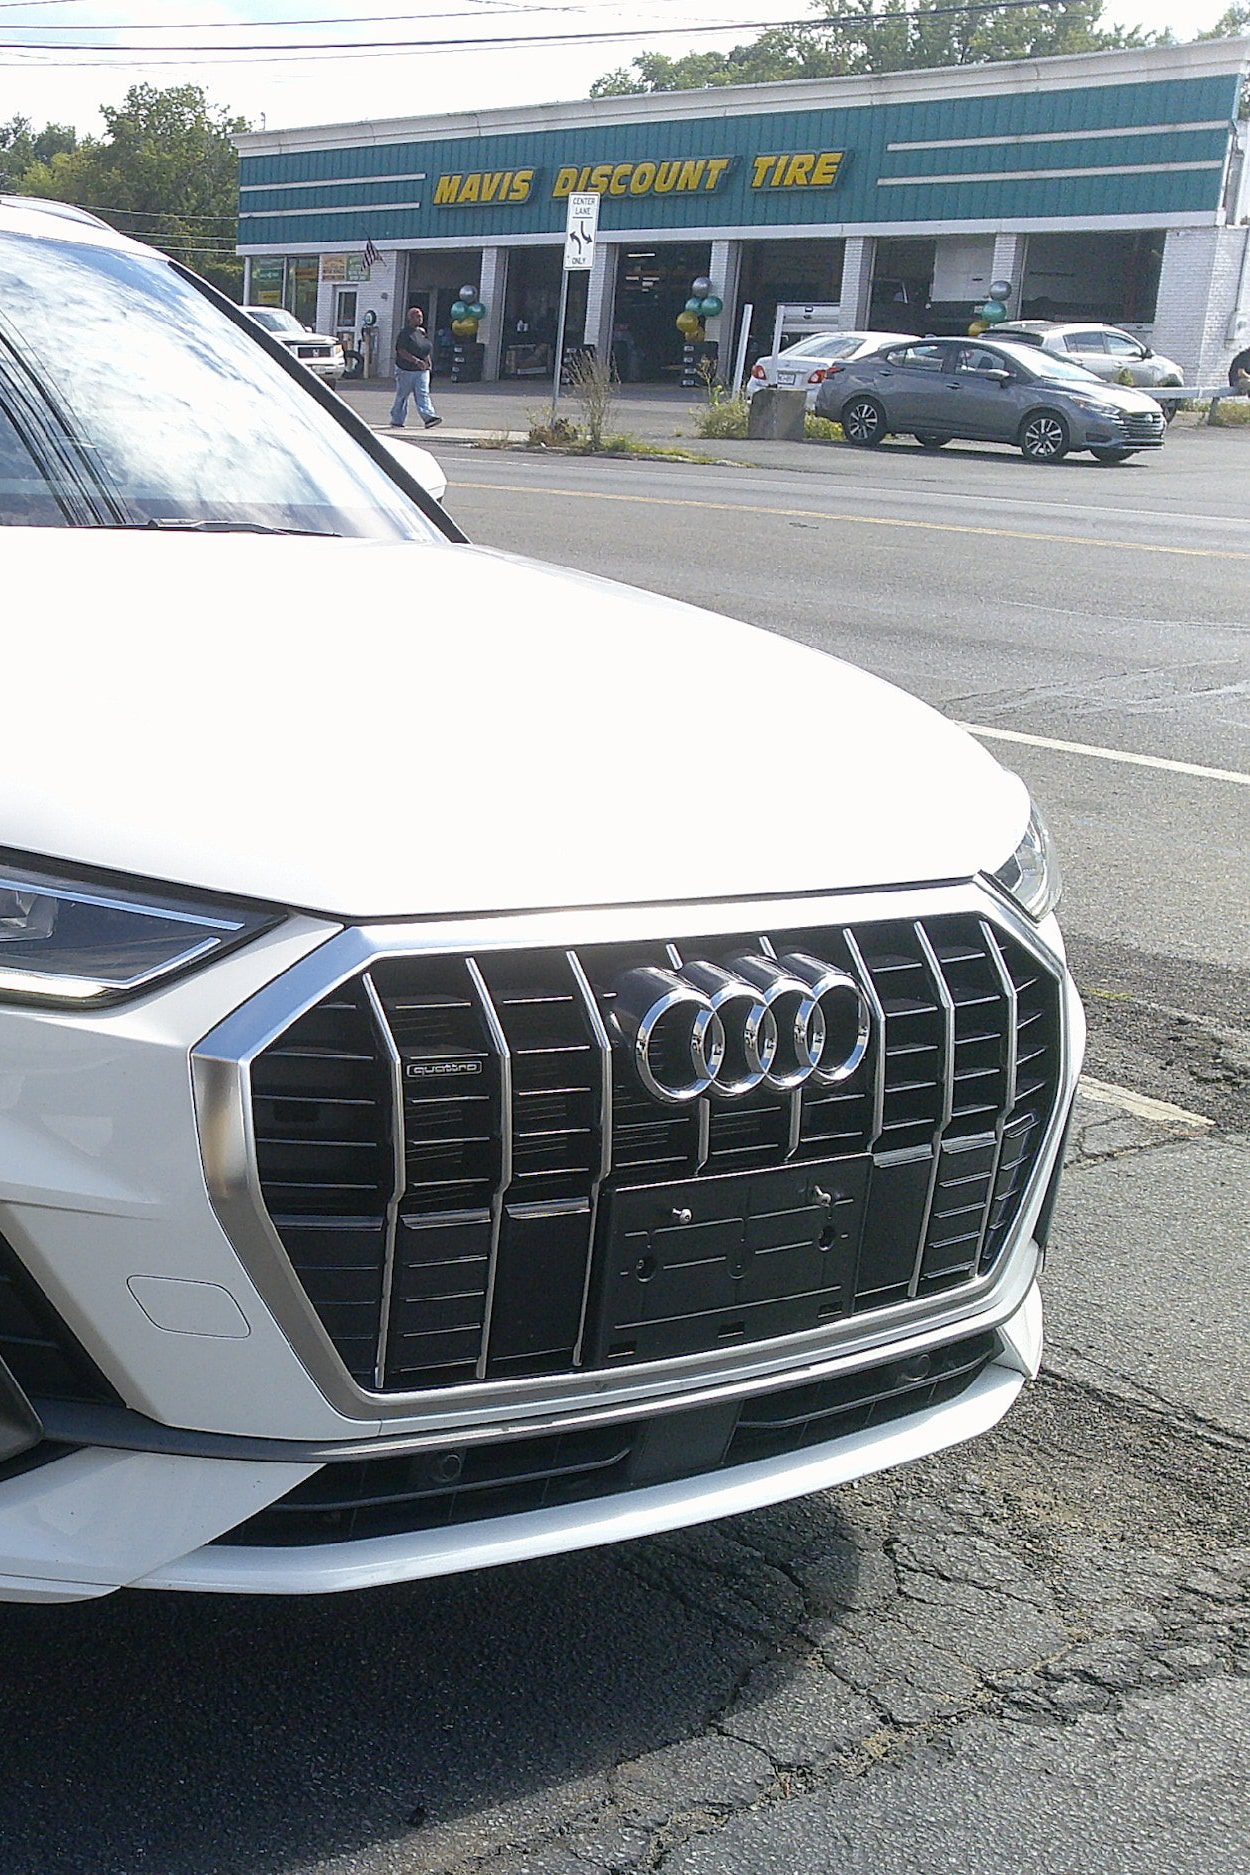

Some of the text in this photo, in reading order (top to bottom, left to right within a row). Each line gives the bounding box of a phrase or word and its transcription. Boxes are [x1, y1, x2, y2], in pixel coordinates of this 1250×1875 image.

[433, 152, 843, 205] MAVIS DISCOUNT TIRE
[572, 197, 596, 206] CENTER
[575, 207, 591, 215] LANE
[571, 257, 587, 265] ONLY
[413, 1063, 477, 1076] quattro
